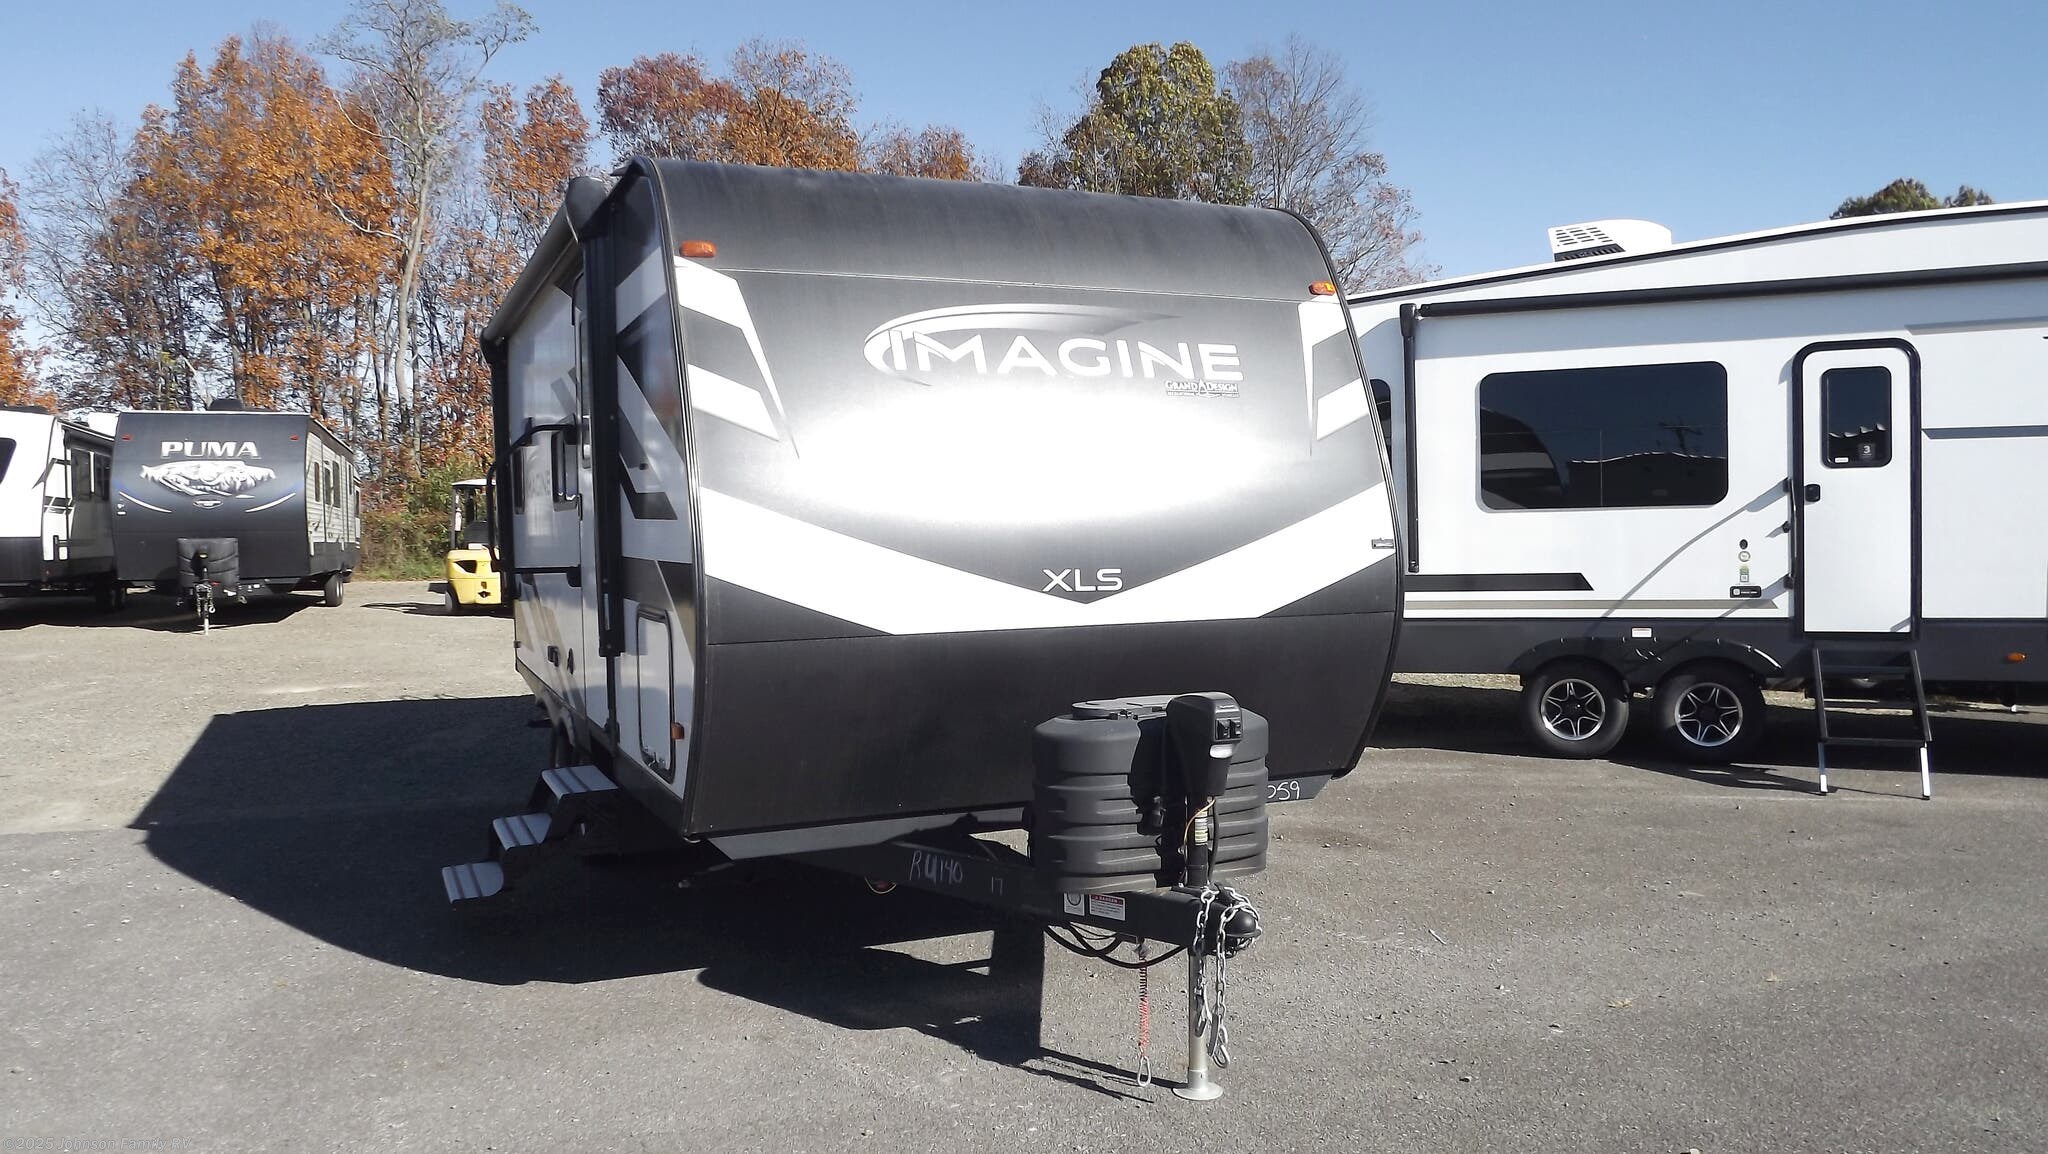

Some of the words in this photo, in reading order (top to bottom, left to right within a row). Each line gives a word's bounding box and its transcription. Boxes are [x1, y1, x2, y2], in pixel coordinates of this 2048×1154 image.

[888, 329, 1243, 382] IMAGINE
[1165, 380, 1198, 391] GRAND
[1206, 382, 1238, 392] DESIGN
[160, 441, 261, 459] PUMA
[1863, 445, 1871, 454] 3
[1042, 568, 1123, 592] XLS
